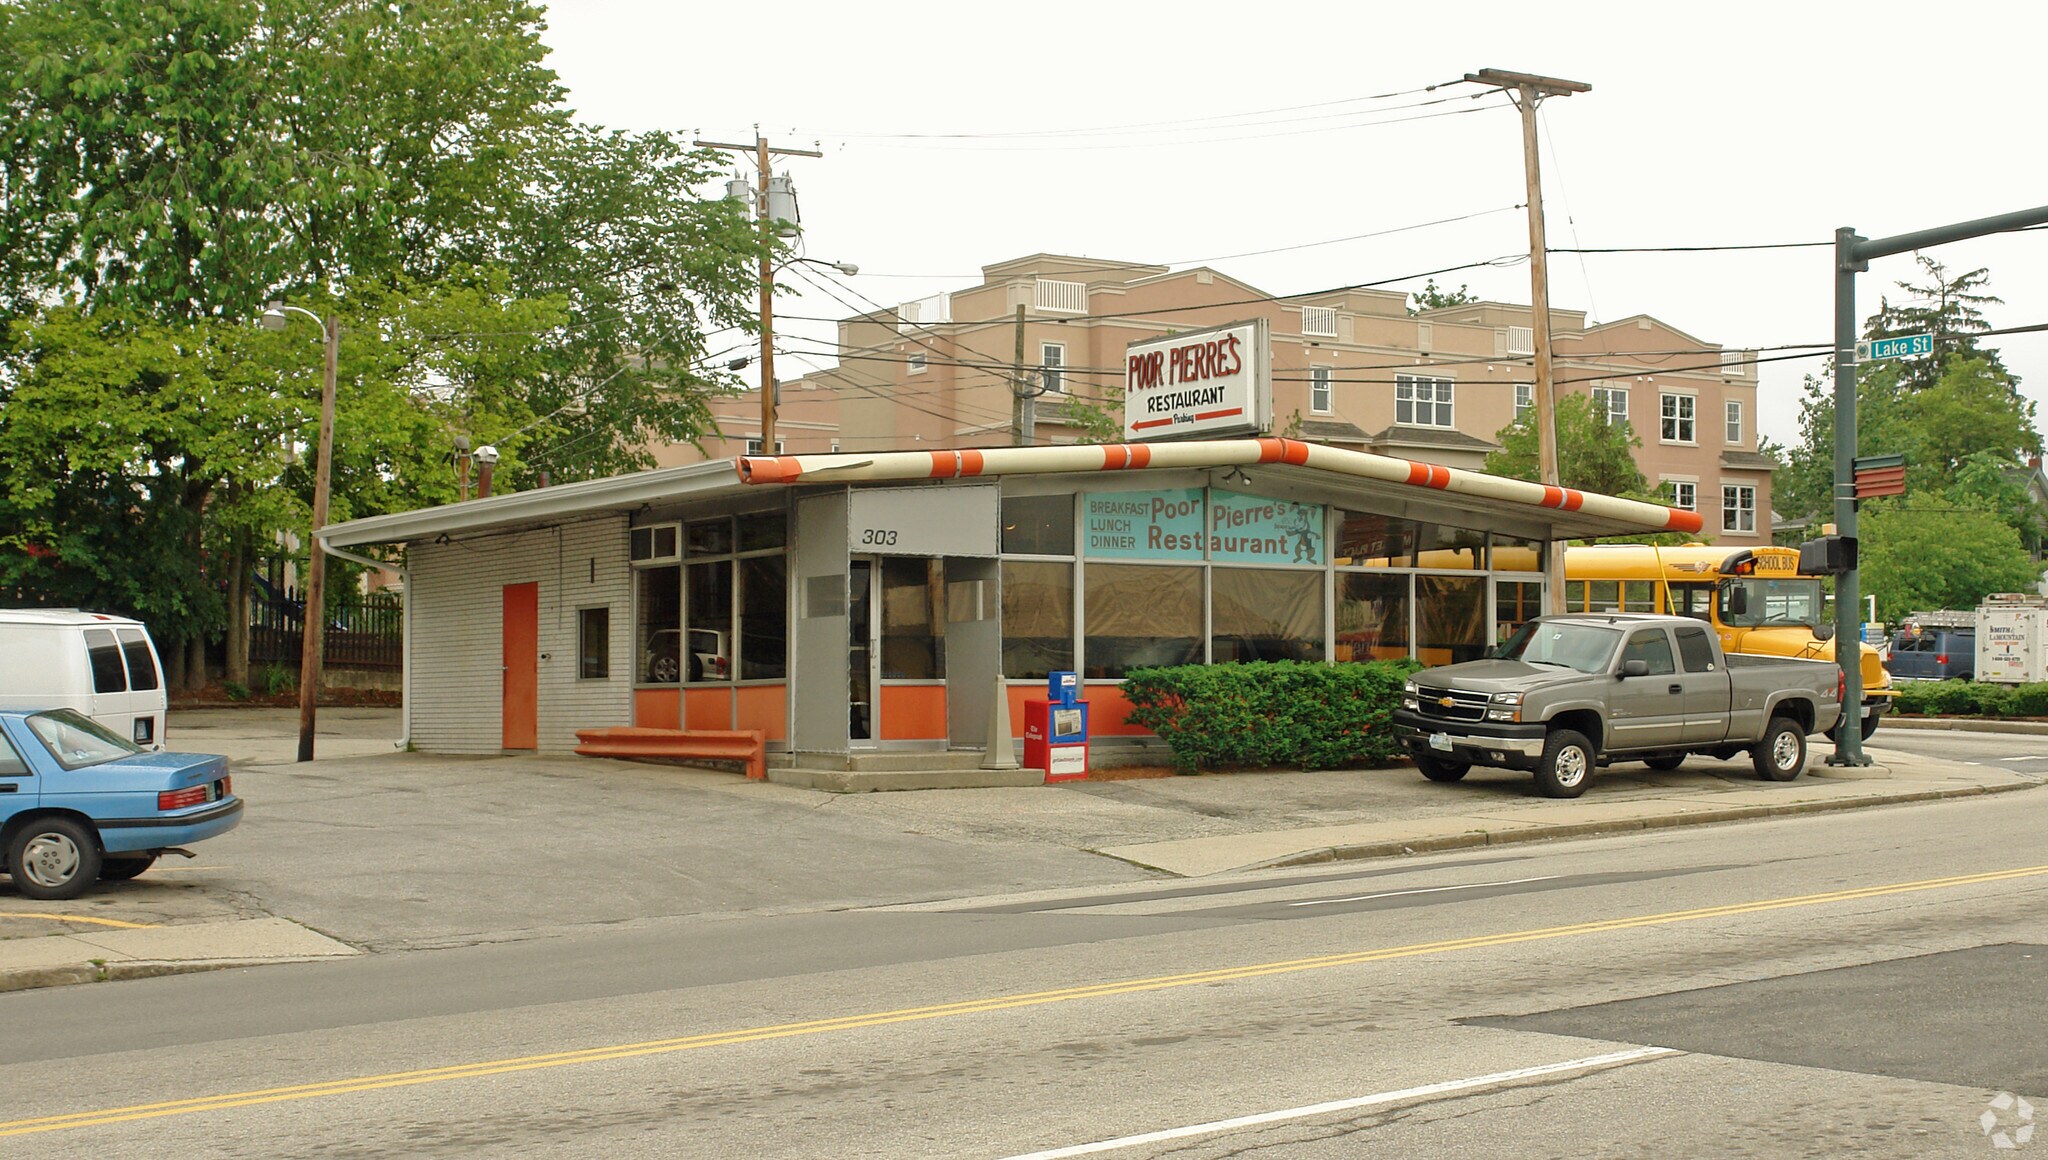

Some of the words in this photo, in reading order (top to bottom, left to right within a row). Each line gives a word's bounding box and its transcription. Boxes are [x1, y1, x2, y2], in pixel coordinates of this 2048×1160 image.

[1875, 340, 1907, 358] Lake
[1913, 337, 1928, 352] St
[1128, 351, 1164, 392] POOR
[1169, 333, 1241, 386] PIERRE'S
[1148, 386, 1225, 413] RESTAURANT
[1173, 413, 1195, 424] Parking
[1090, 500, 1149, 515] BREAKFAST
[1151, 497, 1200, 523] Poor
[1213, 501, 1286, 532] Pierre's
[1090, 518, 1131, 532] LUNCH
[862, 529, 898, 546] 303
[1090, 535, 1136, 549] DINNER
[1757, 556, 1781, 570] SCHOOL
[1782, 556, 1795, 571] BUS
